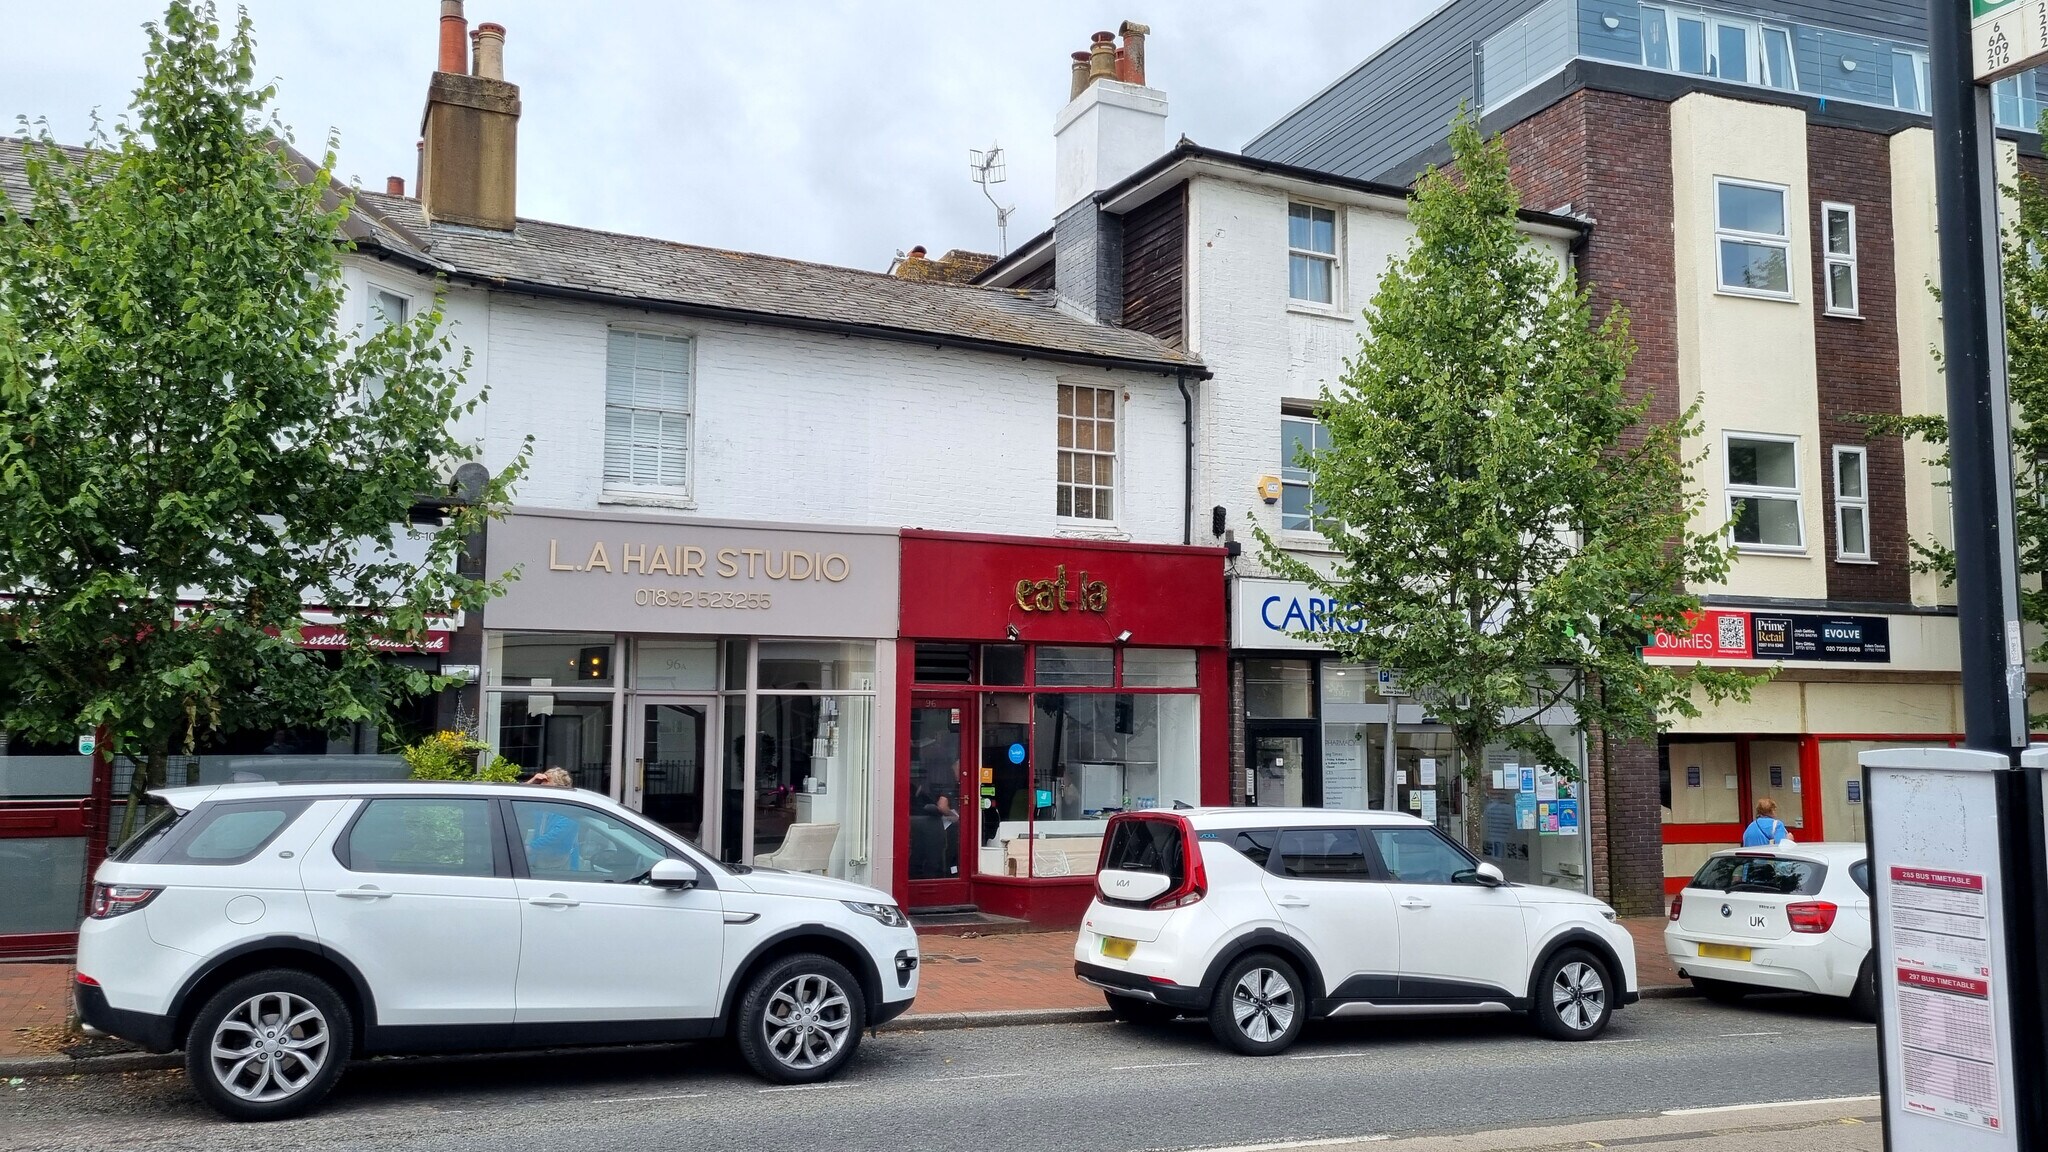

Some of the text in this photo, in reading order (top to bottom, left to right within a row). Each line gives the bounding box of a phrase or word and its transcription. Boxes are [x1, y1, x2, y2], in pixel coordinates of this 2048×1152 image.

[1993, 22, 2000, 32] 6
[1989, 32, 2006, 47] 6A
[1987, 42, 2009, 59] 209
[1988, 54, 2010, 70] 216
[550, 538, 850, 582] L.A HAIR STUDIO
[1016, 564, 1108, 612] eat la
[634, 588, 773, 609] 01892 523255
[1758, 620, 1785, 631] Prime
[1758, 631, 1785, 642] Retail
[1824, 629, 1860, 639] EVOLVE
[925, 700, 937, 708] 96
[1915, 872, 1930, 880] BUS
[1931, 874, 1971, 885] TIMETABLE
[1749, 916, 1765, 927] UK
[1921, 975, 1935, 984] BUS
[1936, 977, 1976, 990] TIMETABLE
